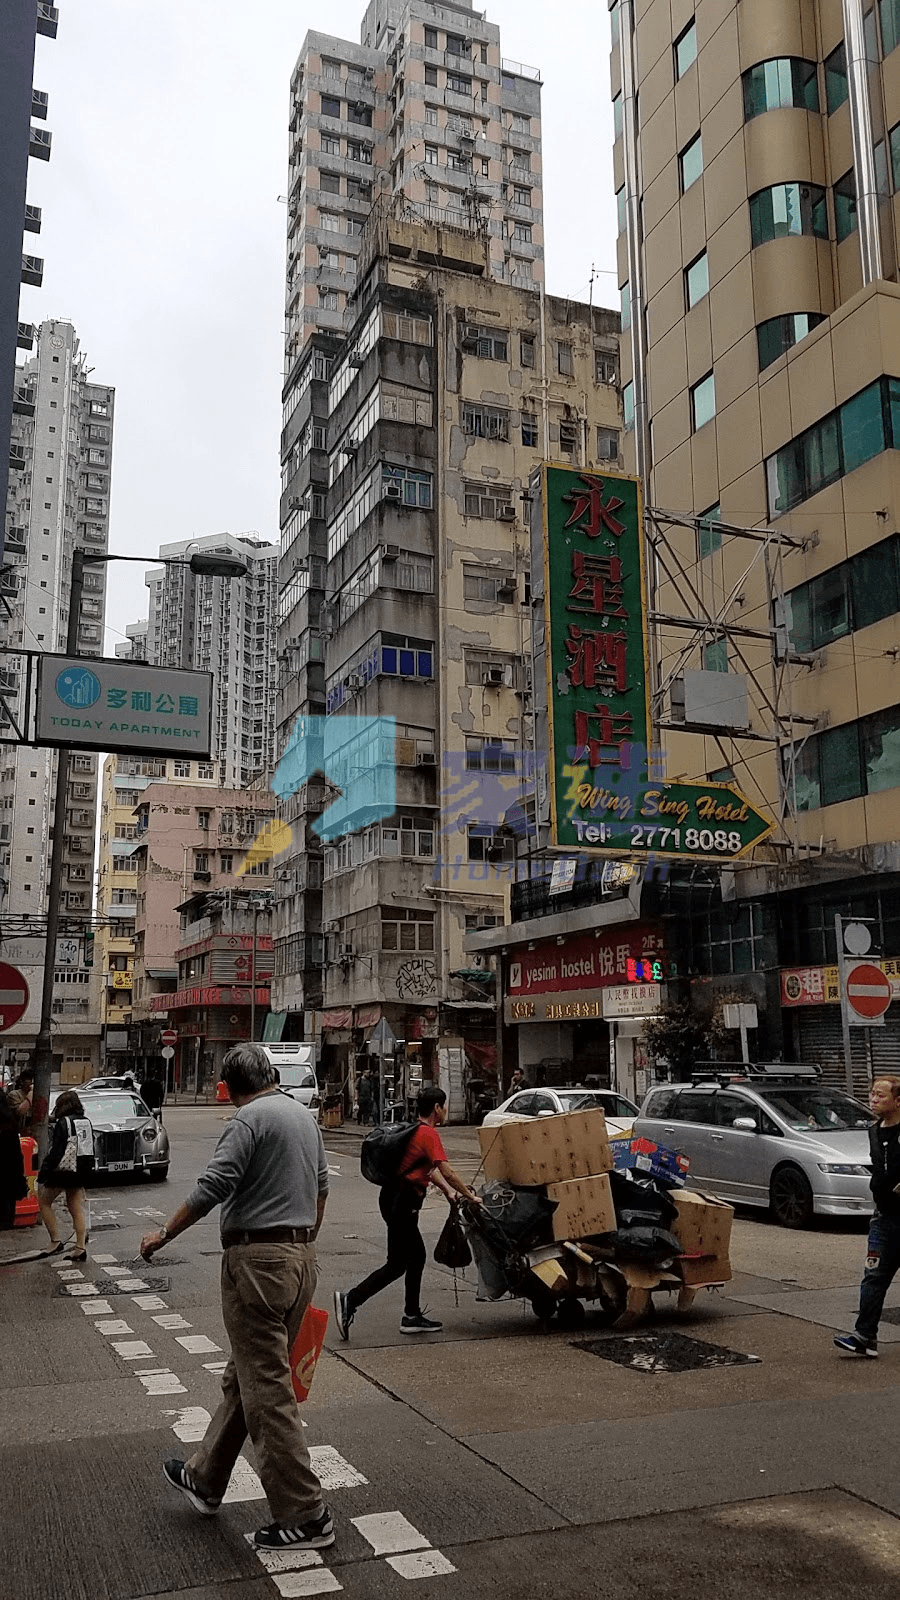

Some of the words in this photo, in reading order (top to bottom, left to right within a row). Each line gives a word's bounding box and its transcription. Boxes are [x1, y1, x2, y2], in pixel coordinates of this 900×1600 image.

[561, 473, 635, 769] 永星酒店
[107, 688, 199, 716] 多利公寓
[51, 716, 103, 729] TODAY
[109, 722, 201, 739] APARTMENT
[577, 783, 633, 820] Wing
[640, 790, 691, 825] Sing
[696, 795, 750, 822] Hotel
[571, 819, 612, 844] Tel:
[526, 961, 558, 988] yesinn
[560, 953, 595, 979] hostel
[114, 1163, 129, 1171] DUN
